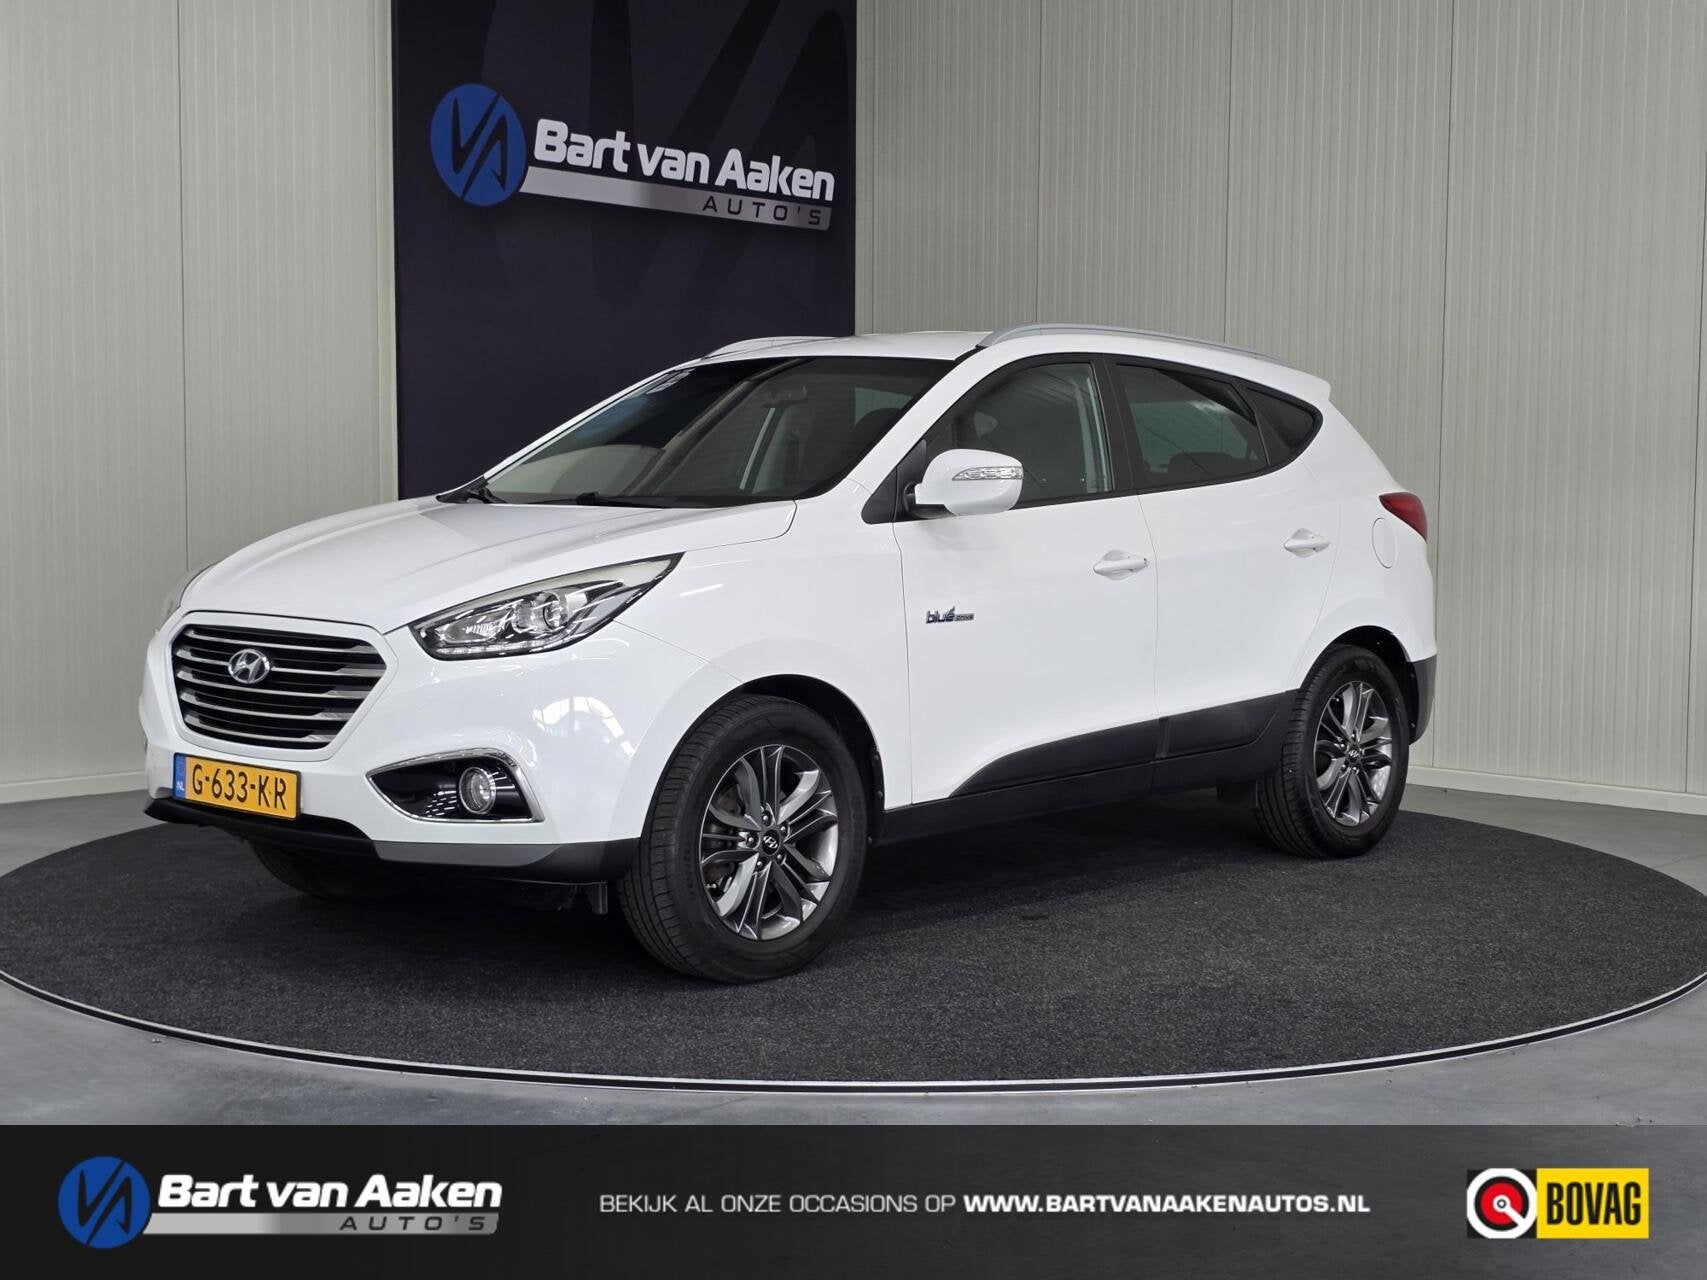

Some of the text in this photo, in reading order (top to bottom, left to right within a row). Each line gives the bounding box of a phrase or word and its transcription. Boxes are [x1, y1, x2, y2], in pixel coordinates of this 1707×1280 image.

[533, 117, 836, 201] Bart van Aaken
[702, 194, 822, 226] AUTO'S
[192, 763, 287, 810] G-633-KR
